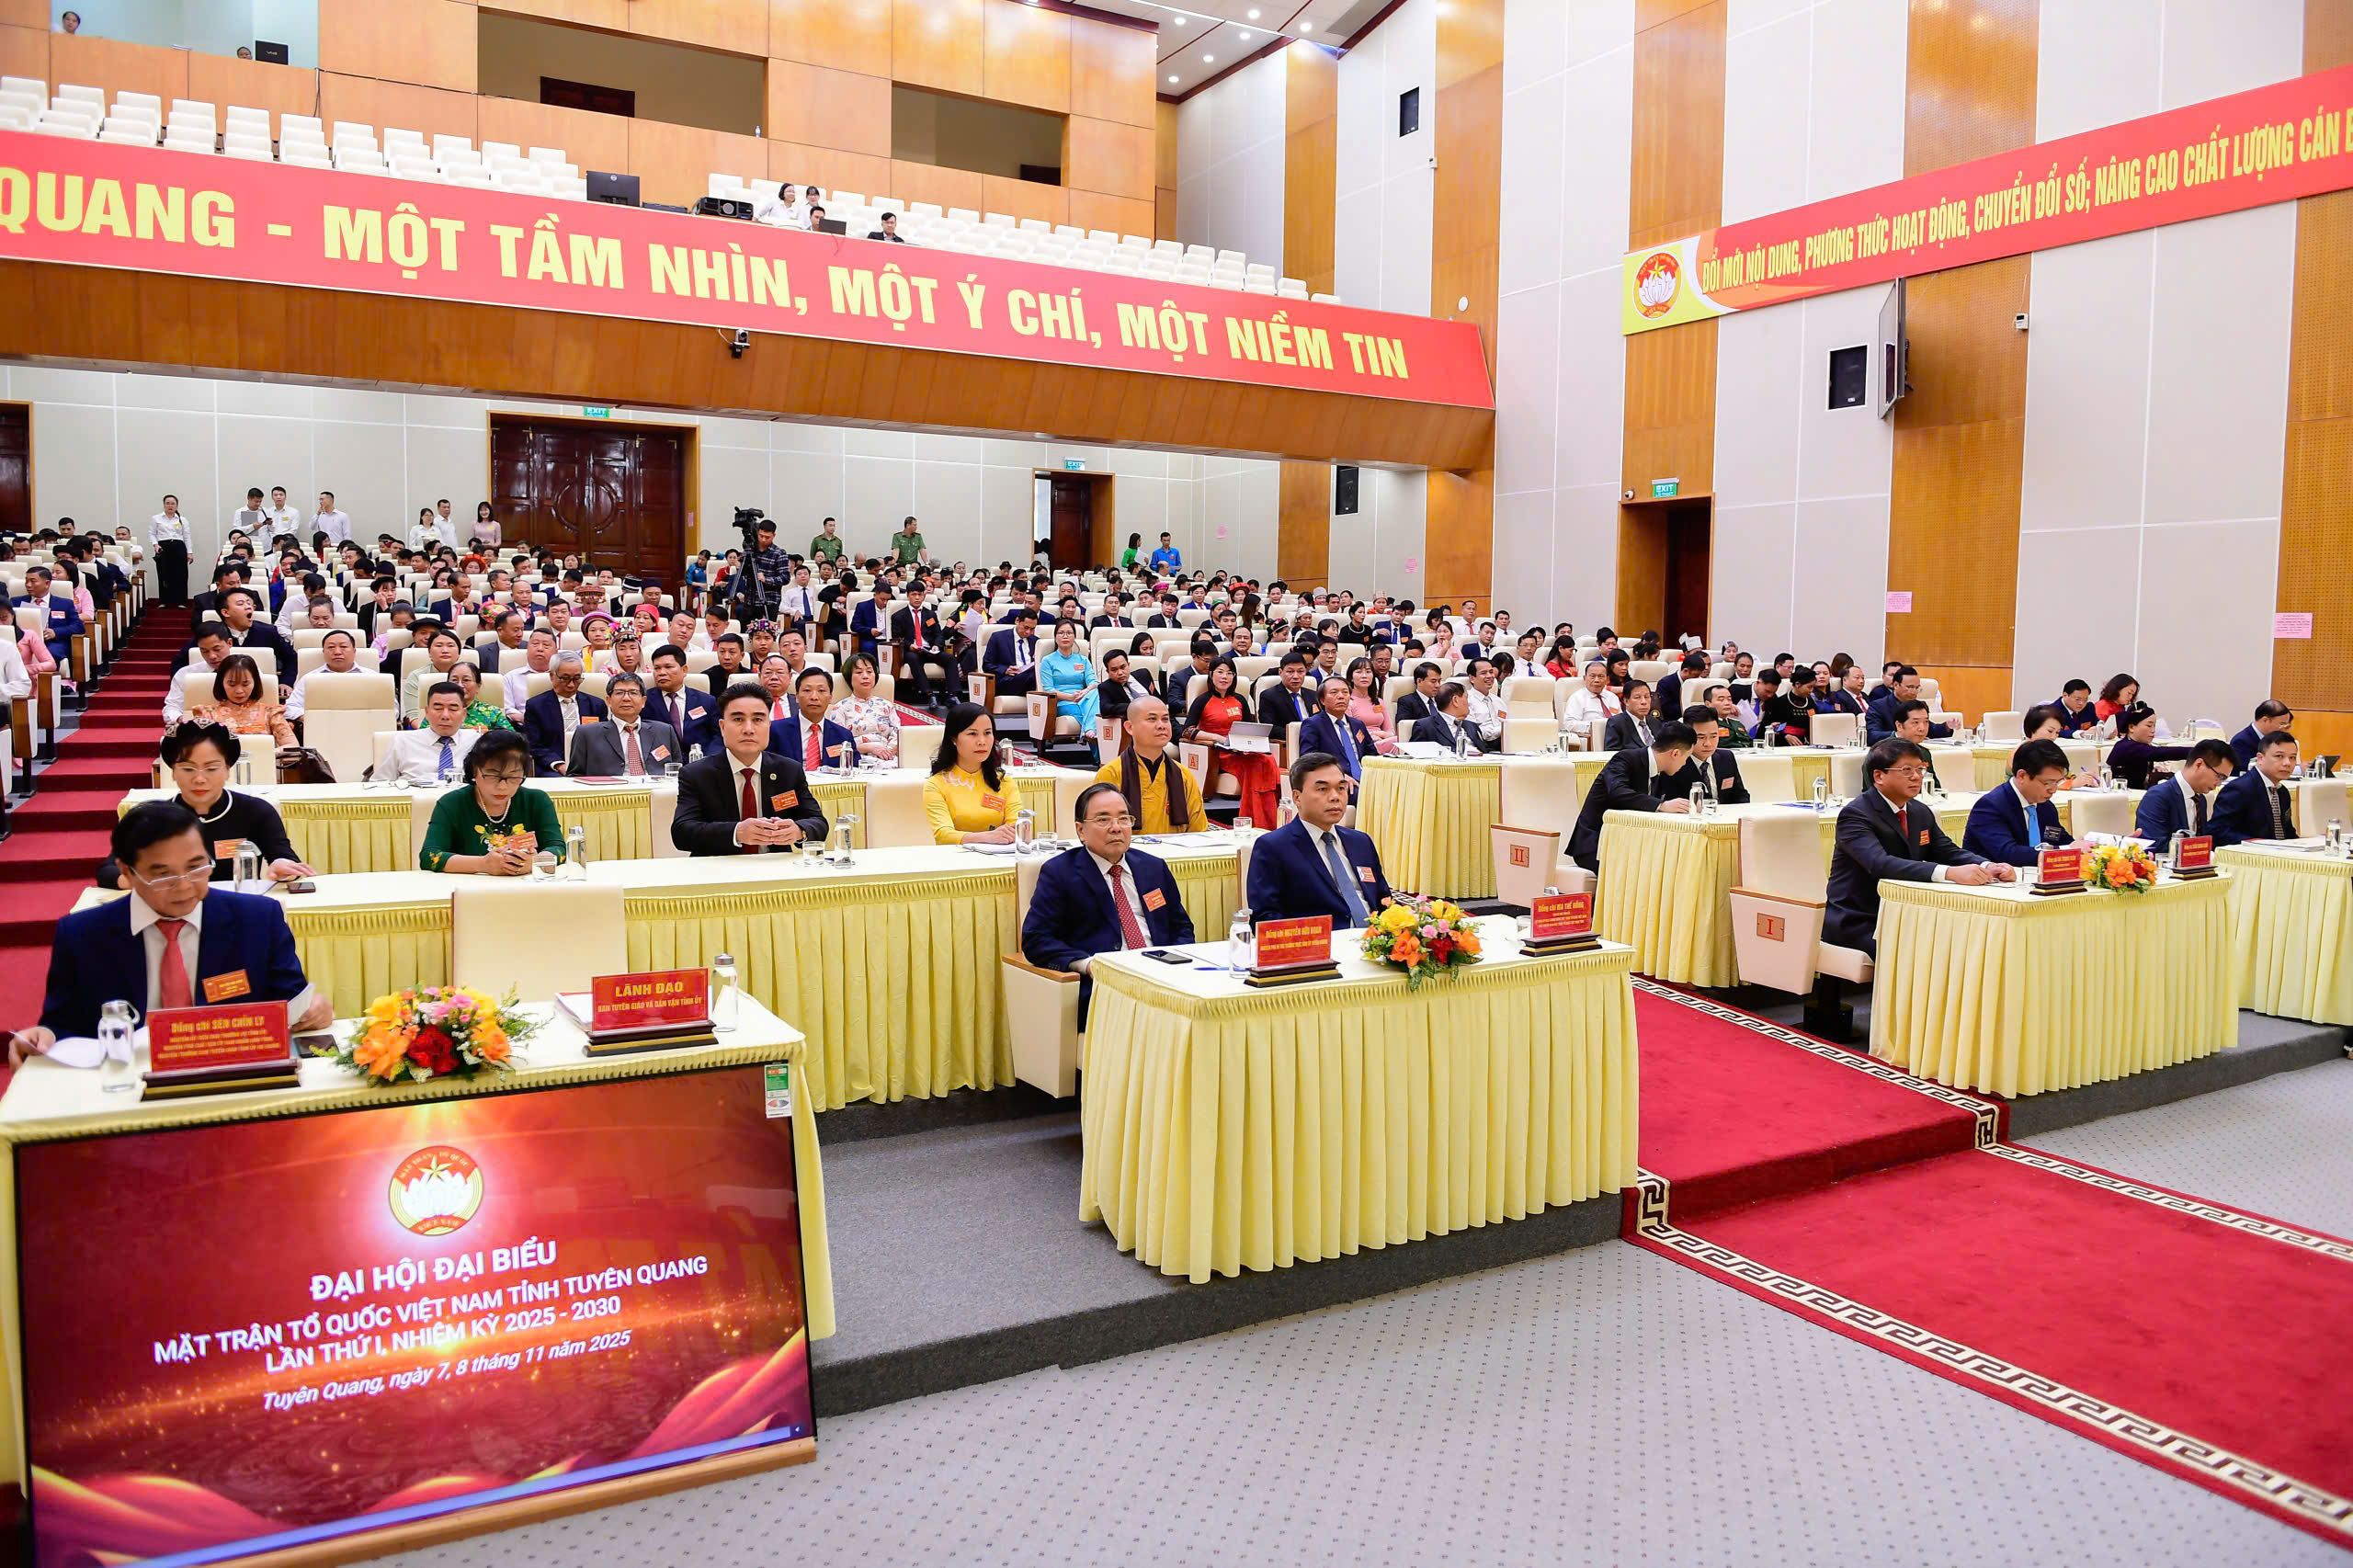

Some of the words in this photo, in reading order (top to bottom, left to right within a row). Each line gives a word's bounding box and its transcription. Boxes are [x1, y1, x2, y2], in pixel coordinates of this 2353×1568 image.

[1702, 247, 1721, 294] ĐỔI
[1722, 246, 1744, 289] MỚI
[1745, 242, 1766, 289] NỘI
[1768, 240, 1802, 278] DUNG,
[1804, 225, 1854, 270] PHƯƠNG
[1858, 212, 1890, 258] THỨC
[1892, 209, 1927, 256] HOẠT
[1928, 197, 1970, 248] ĐỘNG,
[1973, 171, 2032, 233] CHUYỂN
[2035, 163, 2061, 219] ĐỔI
[2095, 155, 2141, 207] NÂNG
[2145, 149, 2178, 196] CAO
[2184, 124, 2229, 187] CHẤT
[2233, 122, 2294, 180] LƯỢNG
[2300, 106, 2340, 162] CÁN
[0, 166, 235, 248] QUANG
[267, 223, 292, 237] -
[324, 202, 466, 279] MỘT
[490, 212, 625, 290] TẦM
[648, 242, 808, 316] NHÌN,
[828, 262, 938, 333] MỘT
[957, 273, 986, 330] Ý
[1007, 286, 1102, 349] CHÍ,
[1118, 301, 1210, 363] MỘT
[1224, 309, 1335, 371] NIỀM
[1342, 332, 1409, 380] TIN
[587, 406, 607, 415] EXIT
[1655, 483, 1674, 493] EXIT
[1189, 756, 1196, 767] A
[615, 983, 652, 997] LÃNH
[655, 981, 684, 995] ĐẠO
[310, 1269, 365, 1301] ĐẠI
[372, 1257, 426, 1292] HỘI
[433, 1252, 484, 1282] ĐẠI
[492, 1236, 557, 1272] BIỂU
[153, 1333, 210, 1364] MẶT
[215, 1322, 283, 1351] TRẬN
[287, 1312, 322, 1341] TỔ
[325, 1303, 392, 1336] QUỐC
[396, 1296, 447, 1324] VIỆT
[451, 1289, 504, 1314] NAM
[507, 1278, 560, 1305] TỈNH
[563, 1267, 632, 1294] TUYÊN
[636, 1256, 709, 1285] QUANG
[266, 1346, 314, 1373] LẦN
[319, 1334, 372, 1364] THỨ
[375, 1335, 388, 1357] I,
[391, 1322, 466, 1352] NHIỆM
[471, 1310, 500, 1338] KỲ
[505, 1306, 556, 1333] 2025
[571, 1296, 621, 1322] 2030
[263, 1386, 319, 1412] Tuyên
[323, 1376, 385, 1400] Quang,
[389, 1364, 435, 1389] ngày
[437, 1362, 451, 1381] 7,
[455, 1358, 469, 1375] 8
[471, 1352, 520, 1374] tháng
[525, 1346, 544, 1363] 11
[548, 1340, 585, 1359] năm
[588, 1329, 632, 1352] 2025
